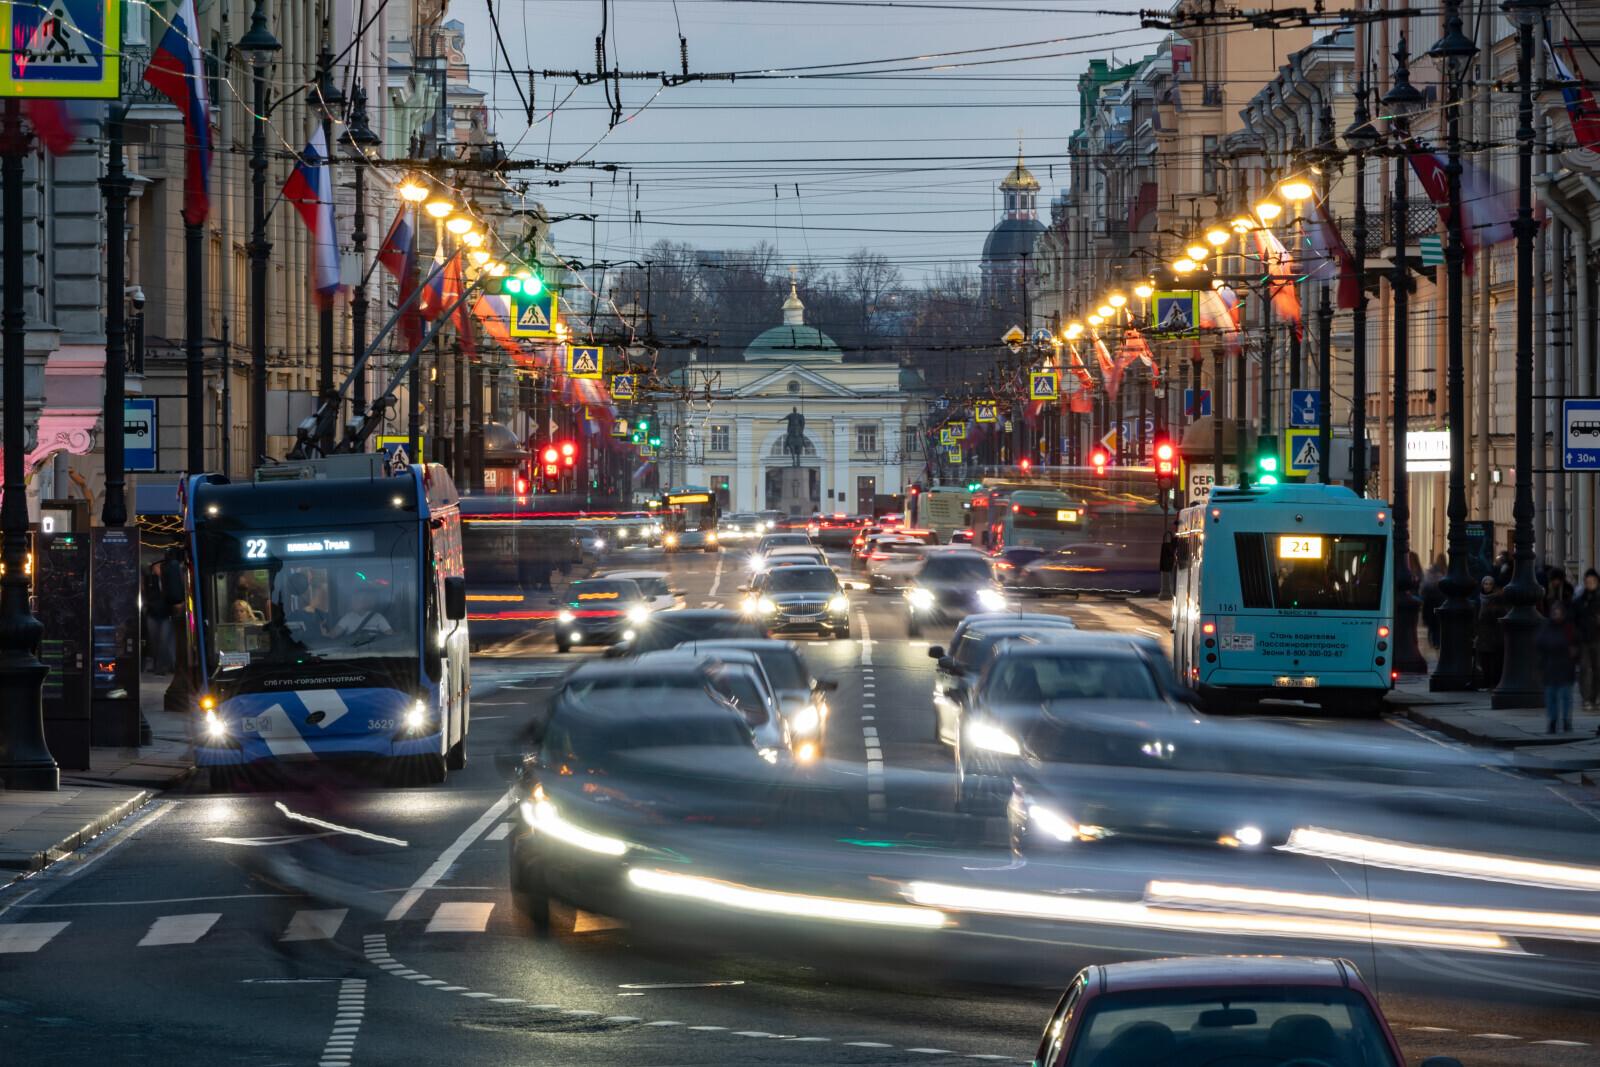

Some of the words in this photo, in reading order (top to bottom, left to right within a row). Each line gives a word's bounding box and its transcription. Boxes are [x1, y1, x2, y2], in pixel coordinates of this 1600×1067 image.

[1577, 454, 1596, 463] 30м
[246, 539, 267, 558] 22
[1292, 541, 1310, 553] 24
[1219, 603, 1237, 612] 1161
[278, 678, 293, 686] ГУП
[367, 719, 395, 730] 3629
